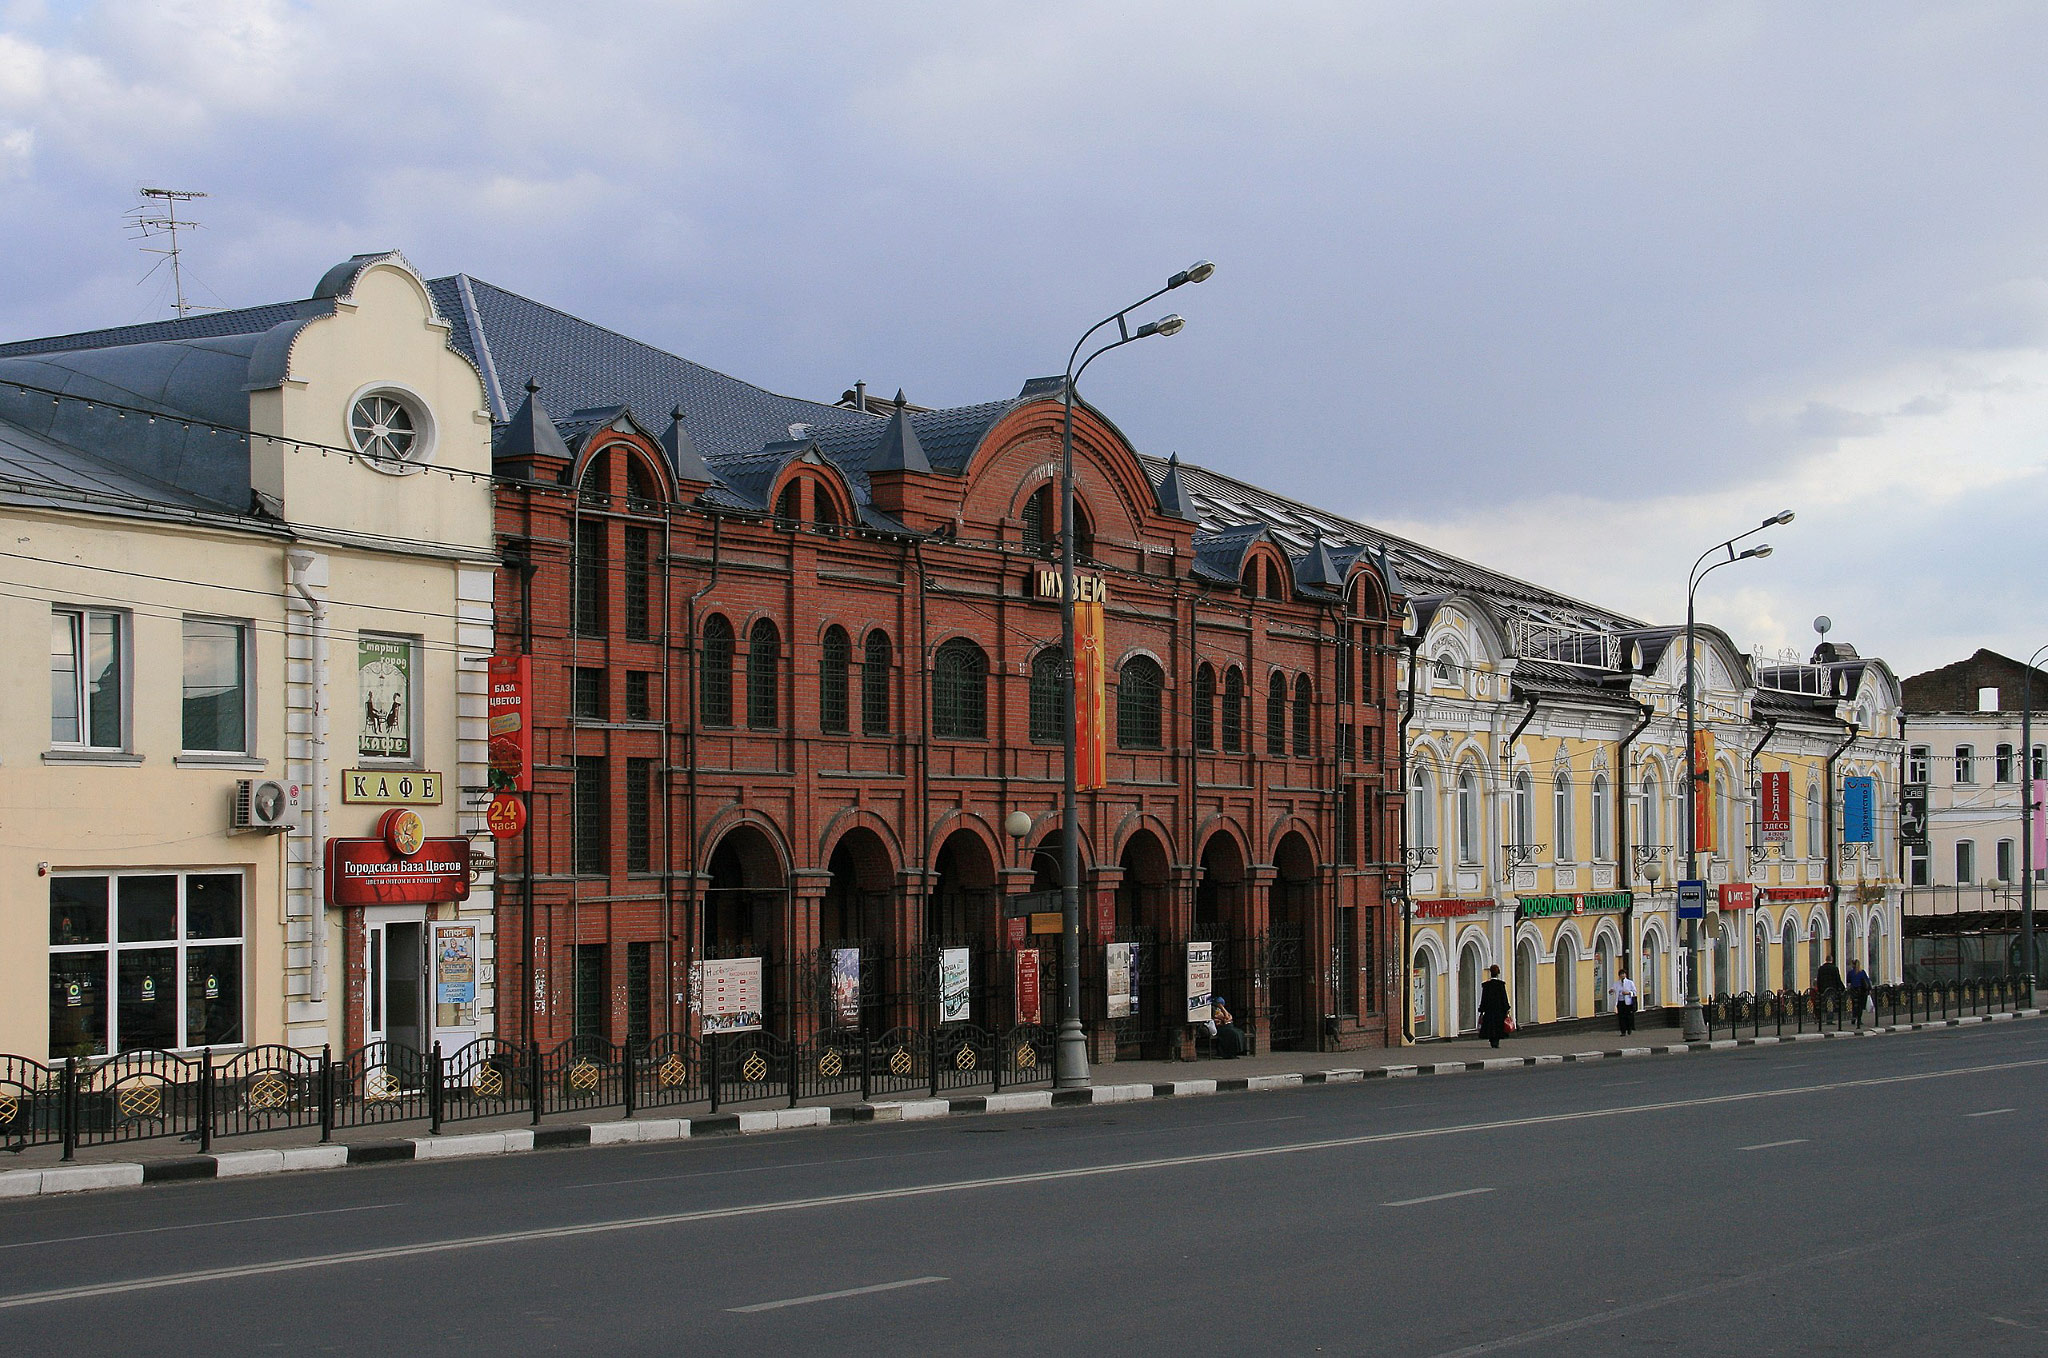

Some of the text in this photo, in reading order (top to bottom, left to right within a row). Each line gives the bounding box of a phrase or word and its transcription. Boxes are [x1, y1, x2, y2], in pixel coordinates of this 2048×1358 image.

[380, 656, 407, 669] город
[494, 684, 516, 693] БАЗА
[490, 696, 521, 706] ЦВЕТОВ
[353, 776, 435, 798] КАФЕ
[1771, 773, 1780, 821] АРЕНДА
[490, 800, 517, 821] 24
[491, 822, 517, 831] часа
[1764, 822, 1789, 830] ЗДЕСЬ
[344, 861, 398, 876] Городская
[400, 860, 424, 873] База
[426, 860, 461, 874] Цветов
[1522, 896, 1575, 916] продукты
[1585, 893, 1632, 910] МАГНОЛИЯ
